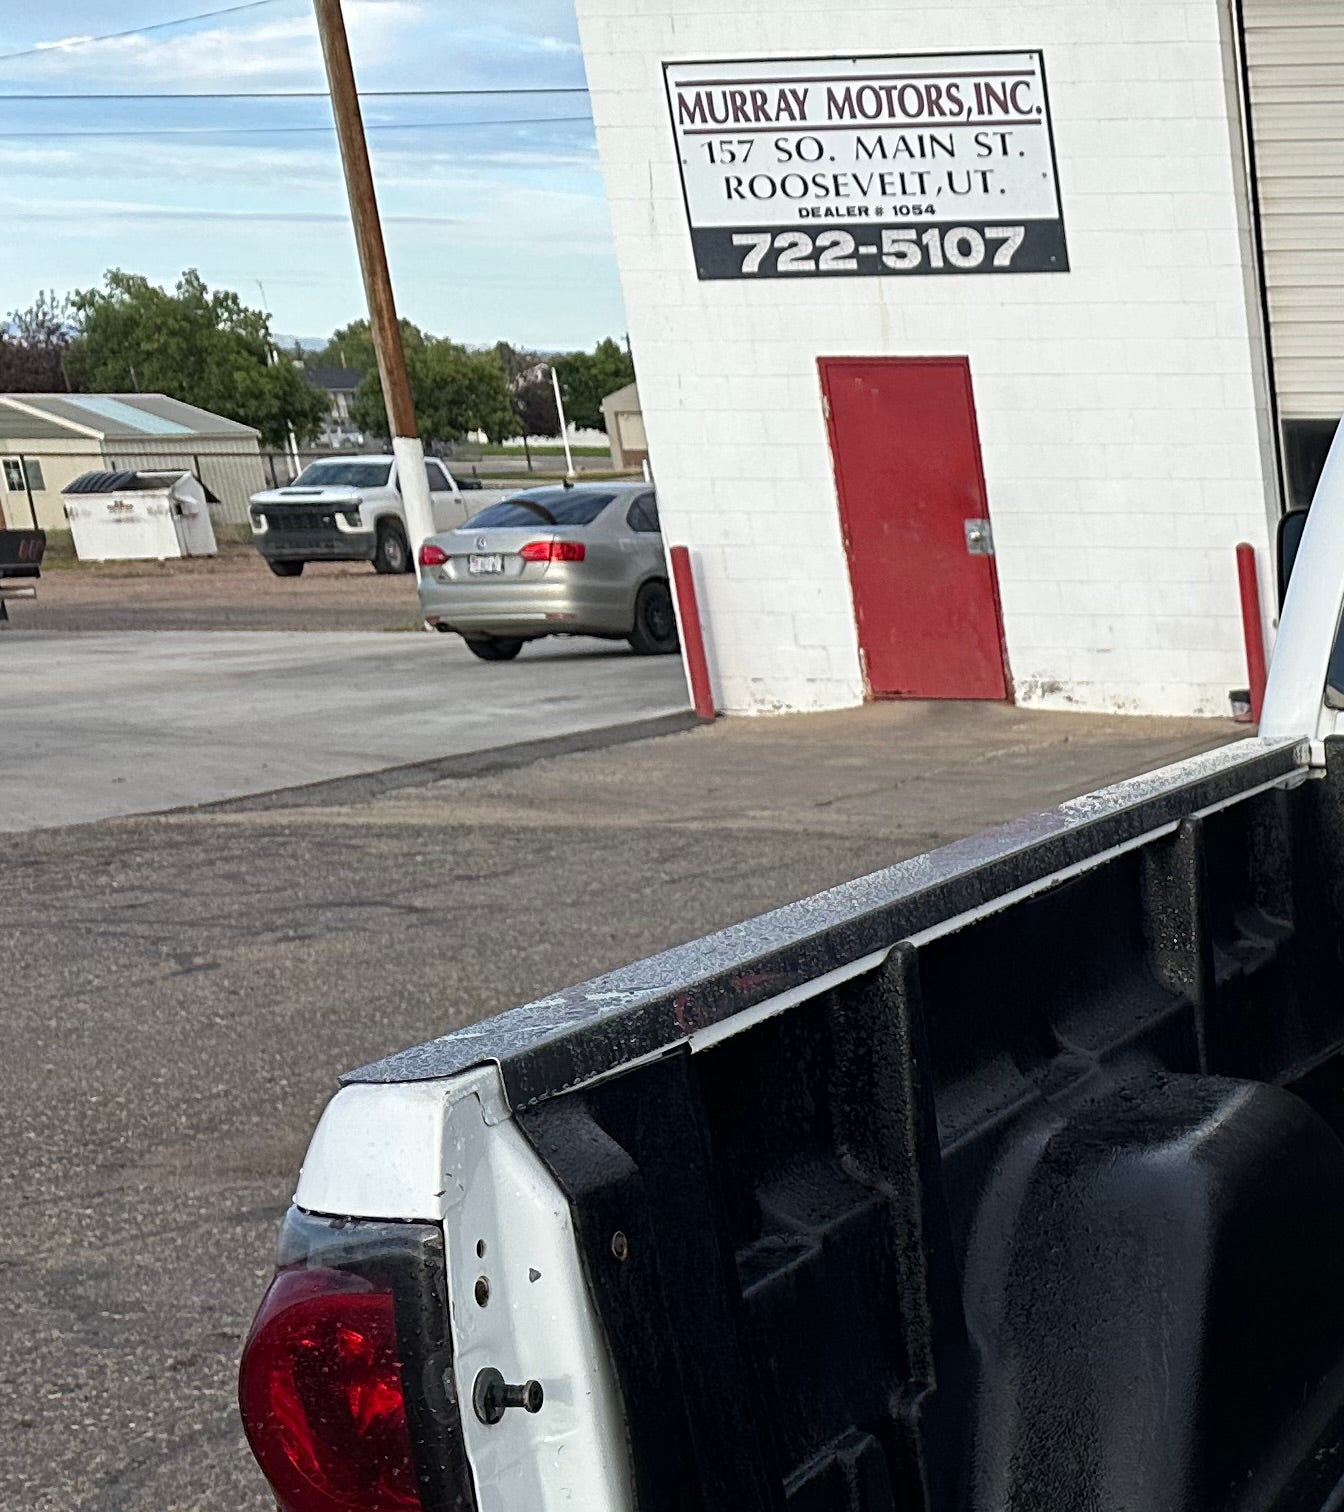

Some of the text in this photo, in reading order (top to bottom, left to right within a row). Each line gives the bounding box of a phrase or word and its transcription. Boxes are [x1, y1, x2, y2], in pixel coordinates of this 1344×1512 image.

[676, 86, 809, 125] MURRAY
[701, 131, 1026, 165] 157 SO. MAIN ST.
[798, 205, 870, 219] DEALER
[892, 203, 937, 217] 1054
[731, 226, 1026, 274] 722-5107
